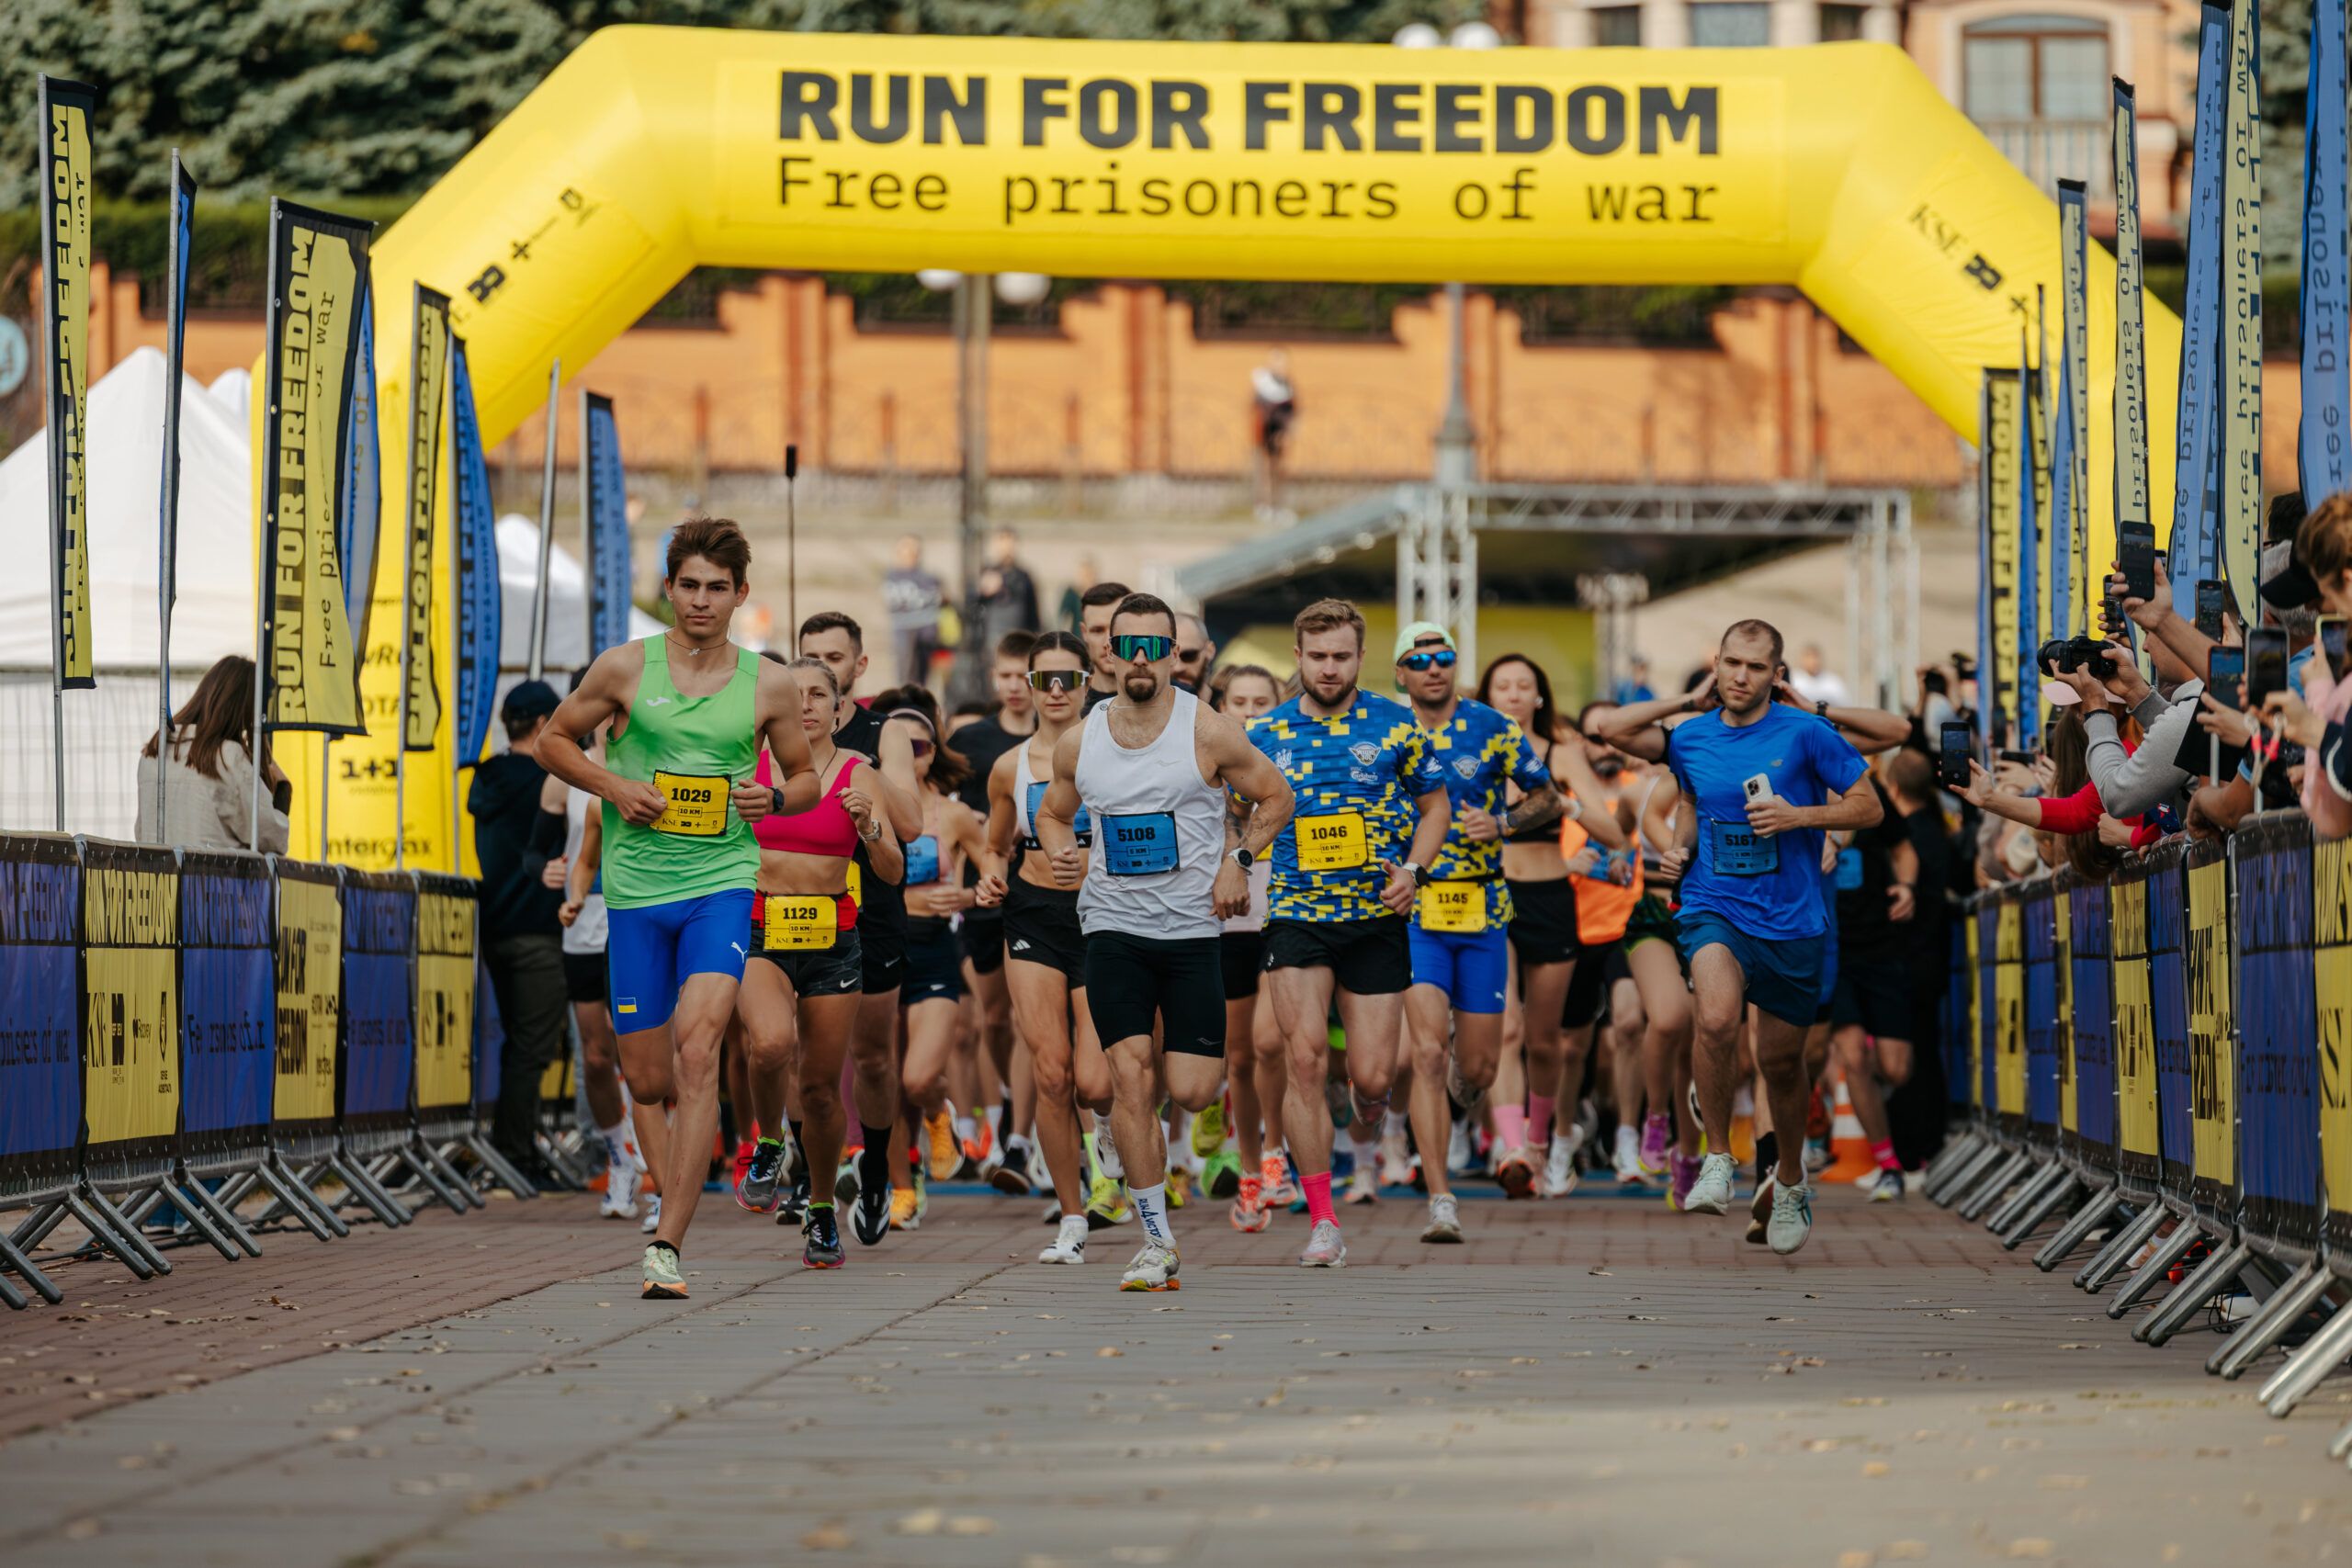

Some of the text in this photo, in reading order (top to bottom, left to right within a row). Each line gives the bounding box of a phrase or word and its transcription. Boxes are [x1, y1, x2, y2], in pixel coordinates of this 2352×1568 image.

[779, 71, 1719, 157] RUN FOR FREEDOM
[780, 156, 1720, 226] Free prisoners of war
[316, 290, 334, 344] war
[277, 225, 317, 723] RUN FOR FREEDOM
[319, 598, 336, 668] Free
[672, 788, 711, 803] 1029
[1117, 827, 1155, 841] 5108
[1311, 826, 1348, 840] 1046
[1724, 834, 1757, 846] 5167
[86, 868, 177, 945] RUN FOR FREEDOM
[783, 908, 818, 919] 1129
[1438, 893, 1468, 904] 1145
[55, 1024, 70, 1063] wa
[278, 1008, 308, 1075] REEDOM
